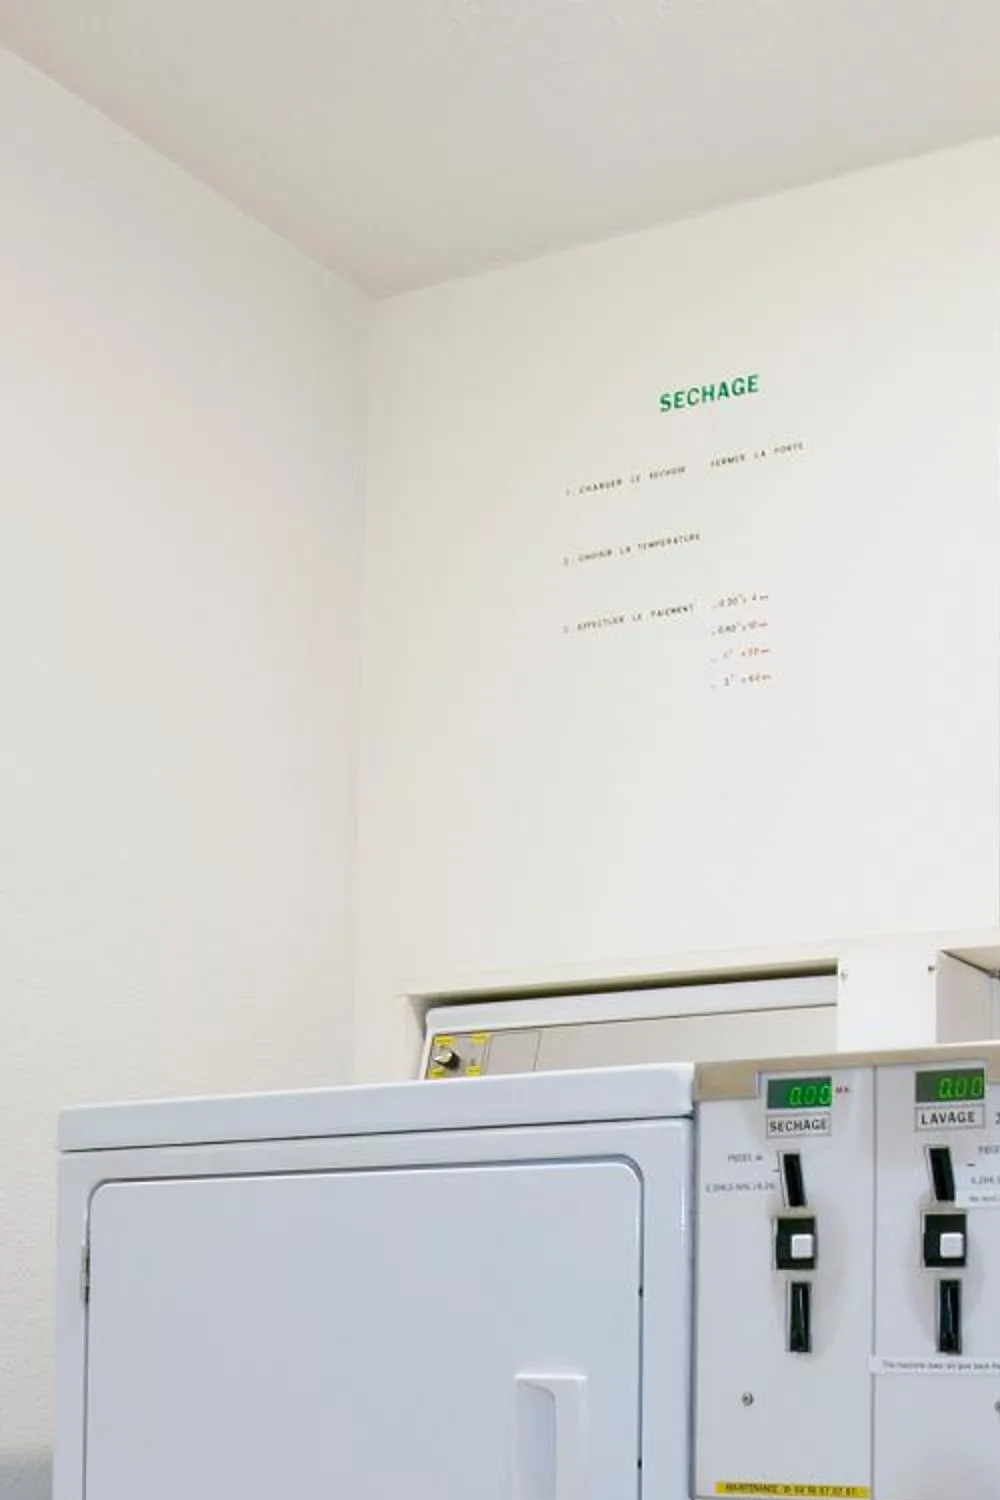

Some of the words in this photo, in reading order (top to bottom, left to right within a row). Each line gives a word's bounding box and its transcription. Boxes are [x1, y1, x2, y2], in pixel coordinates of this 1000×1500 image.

[659, 374, 760, 412] SECHAGE
[637, 532, 701, 553] TEMPERATURE
[769, 1118, 828, 1133] SECHAGE
[920, 1111, 976, 1125] LAVAGE
